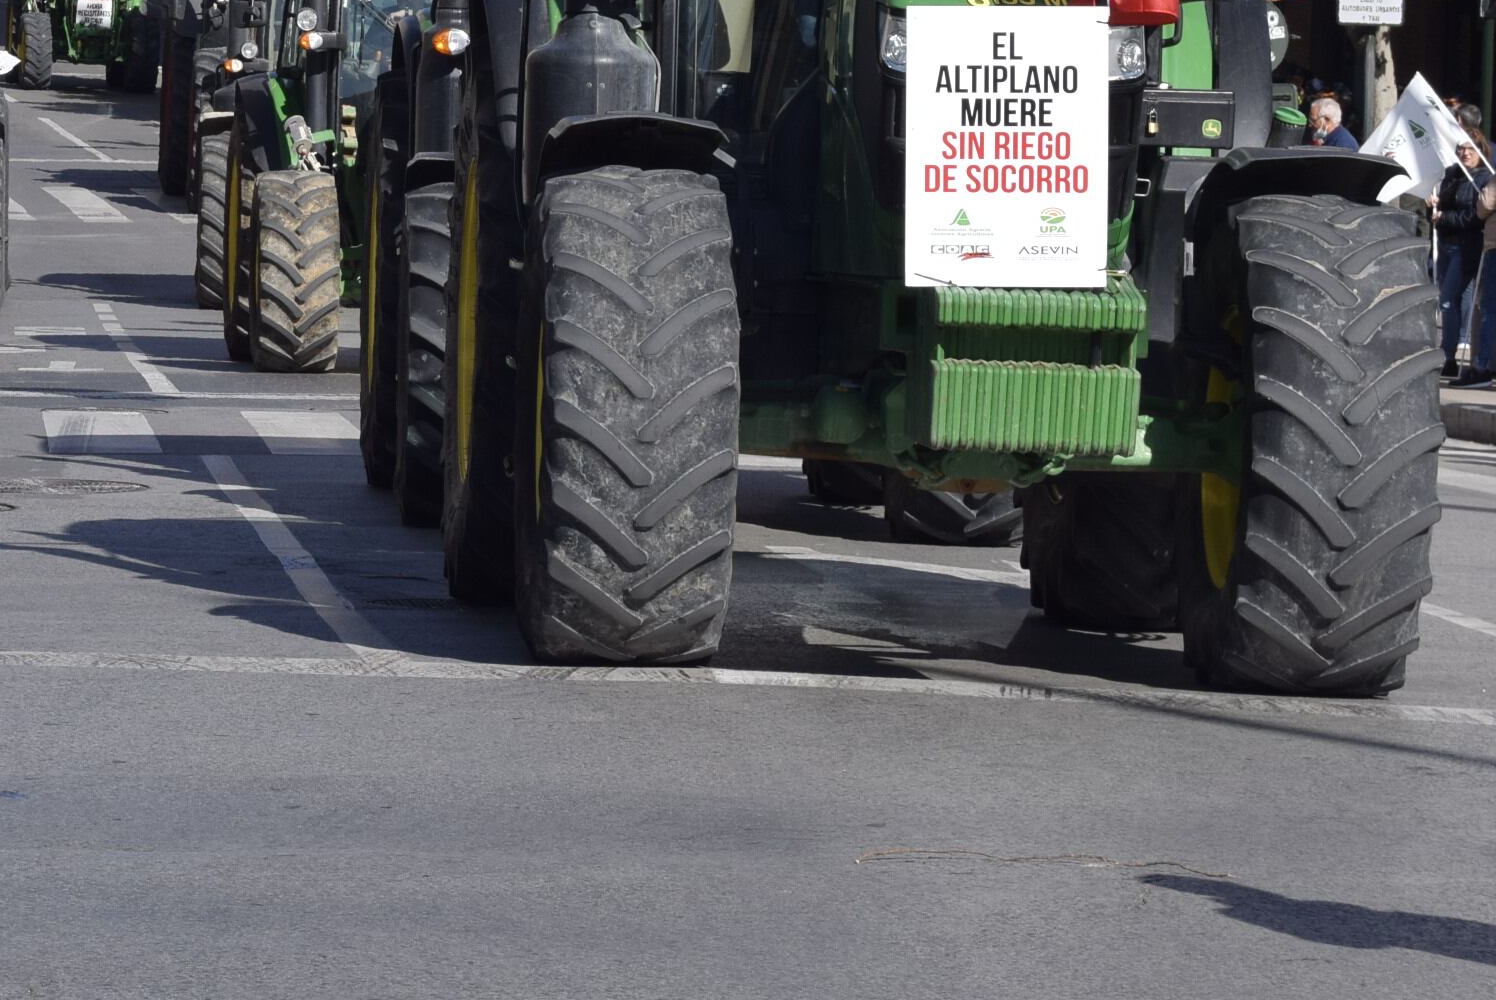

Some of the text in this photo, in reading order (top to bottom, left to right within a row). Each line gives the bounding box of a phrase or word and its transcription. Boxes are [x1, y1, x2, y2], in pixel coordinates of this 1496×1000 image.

[993, 32, 1023, 60] EL
[935, 65, 1078, 93] ALTIPLANO
[961, 98, 1053, 127] MUERE
[942, 131, 1071, 160] SIN RIEGO
[924, 165, 1089, 193] DE SOCORRO
[1039, 226, 1067, 234] UPA
[1018, 245, 1079, 255] ASEVIN
